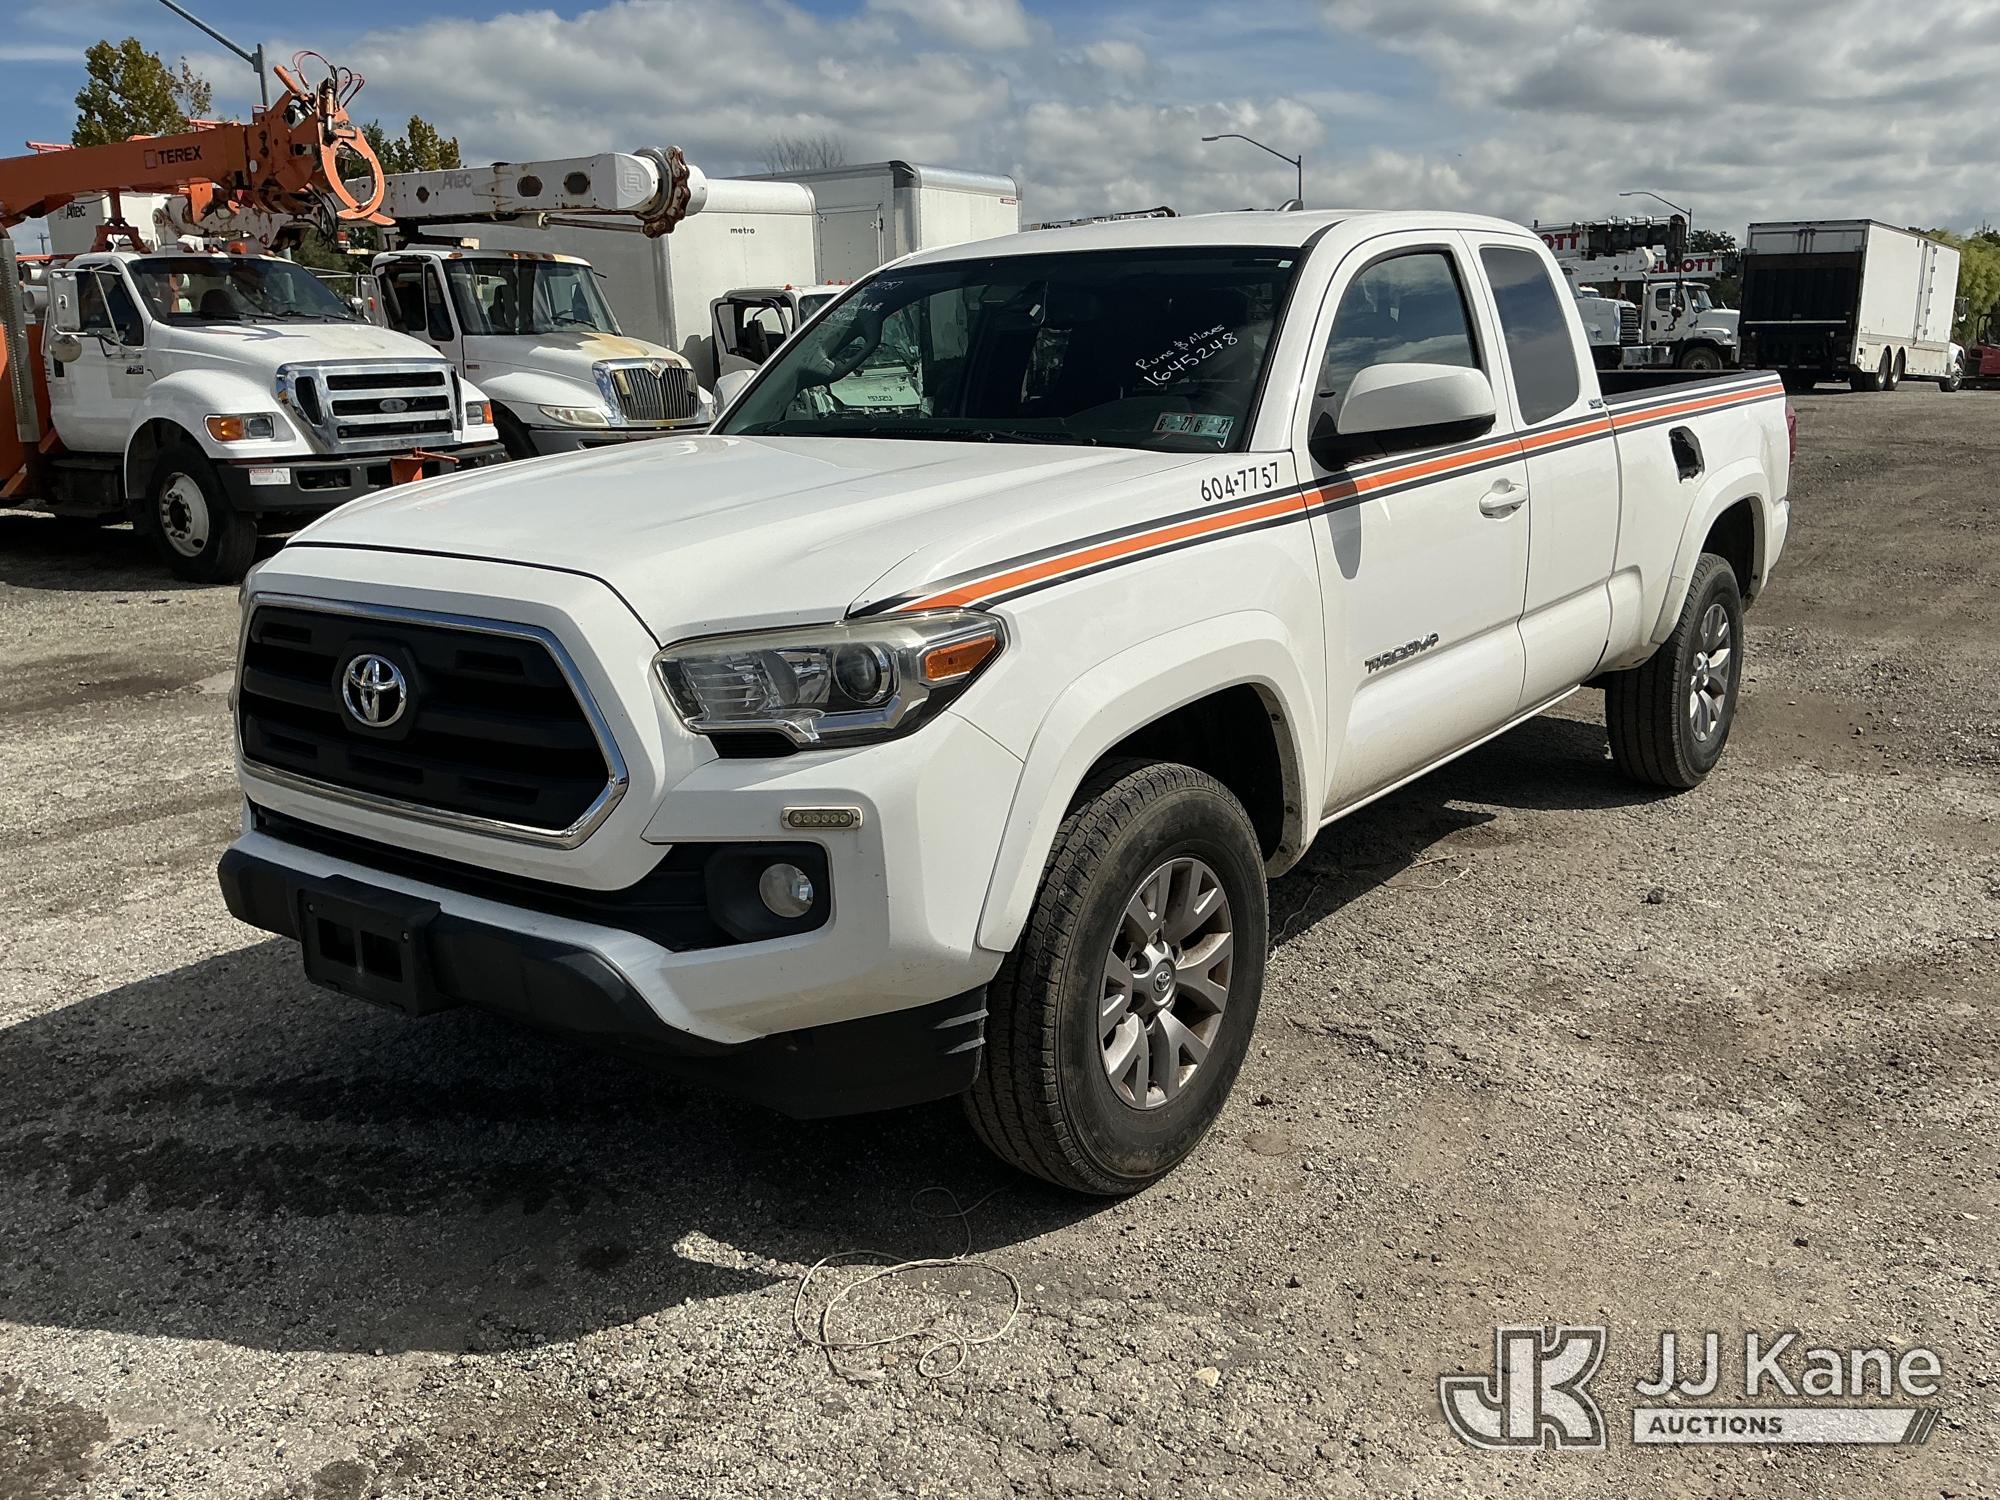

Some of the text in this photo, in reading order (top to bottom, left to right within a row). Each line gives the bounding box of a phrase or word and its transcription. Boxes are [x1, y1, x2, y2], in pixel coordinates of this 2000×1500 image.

[158, 145, 202, 165] TEREX
[1650, 258, 1716, 273] ELOTT
[1143, 331, 1238, 386] 1645248
[1364, 632, 1440, 675] TACOMA
